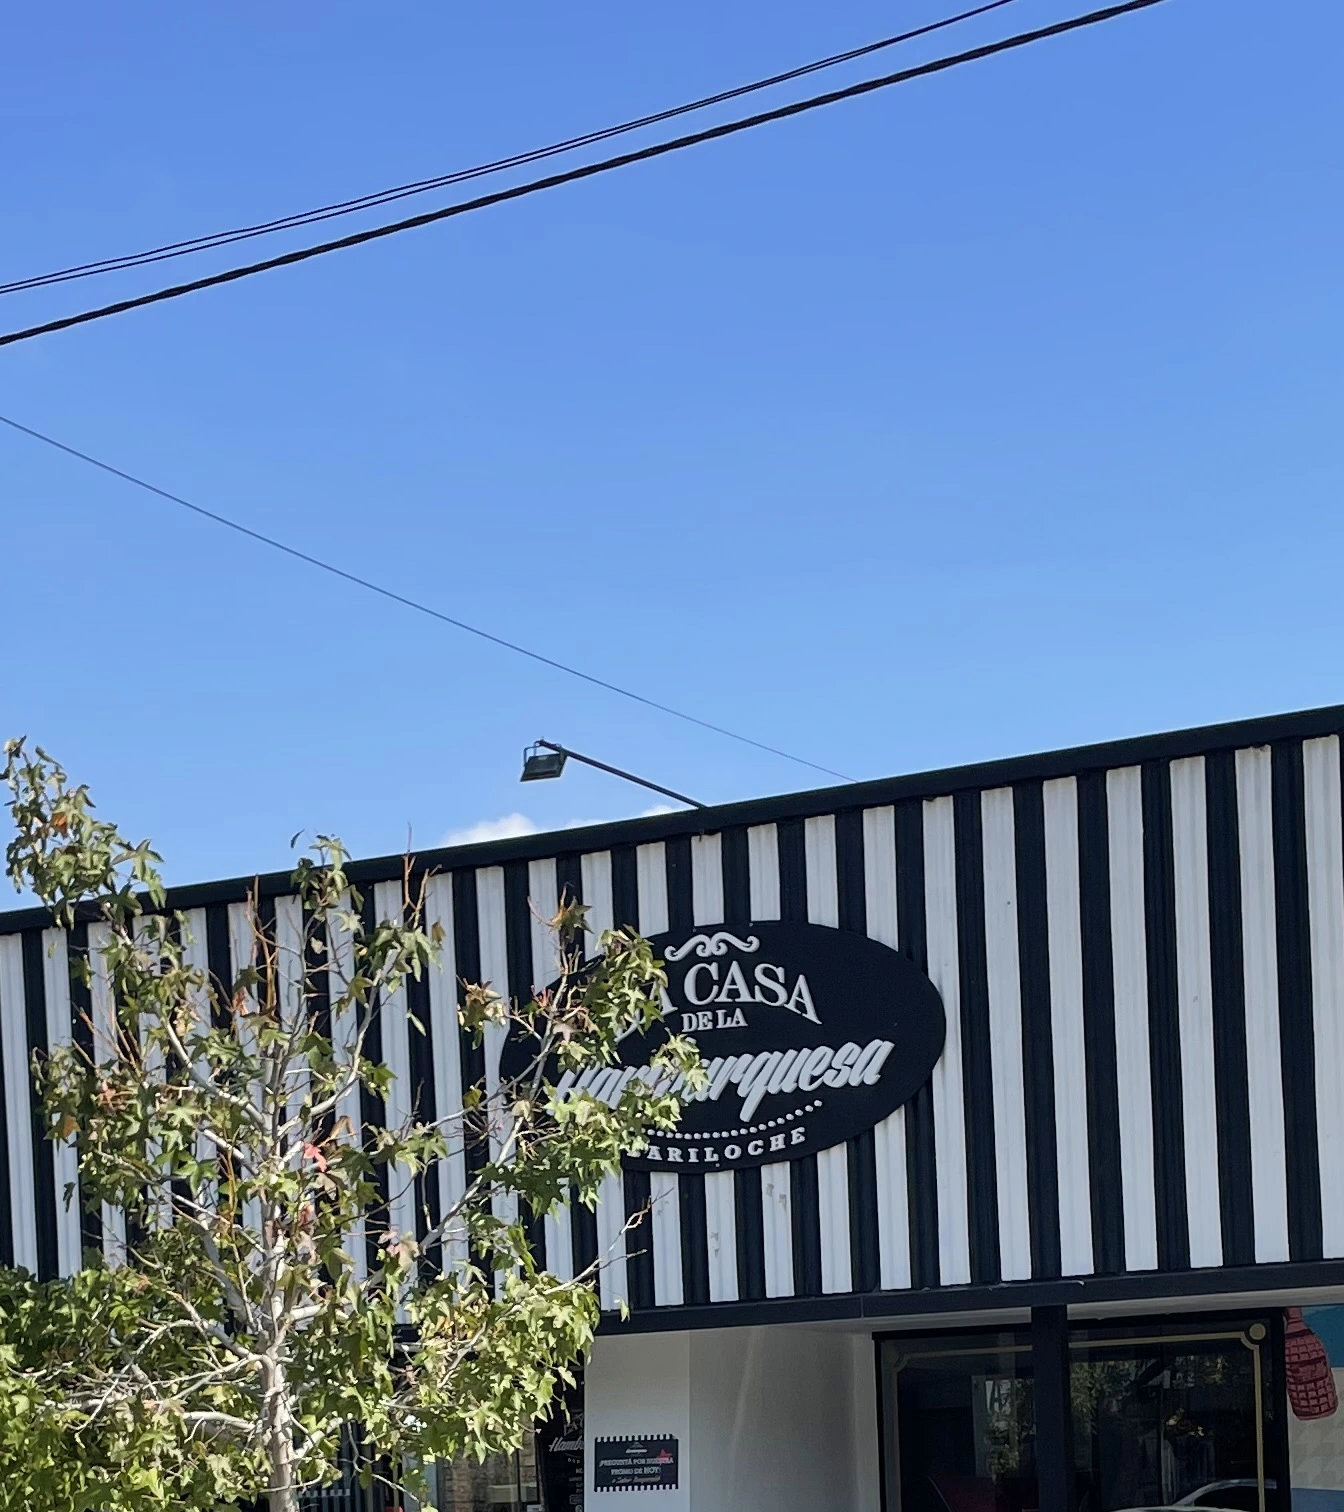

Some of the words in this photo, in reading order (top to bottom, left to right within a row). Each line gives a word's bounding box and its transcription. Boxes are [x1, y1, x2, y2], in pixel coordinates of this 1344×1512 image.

[684, 961, 822, 1025] CASA
[681, 1012, 713, 1032] DE
[716, 1007, 748, 1030] LA
